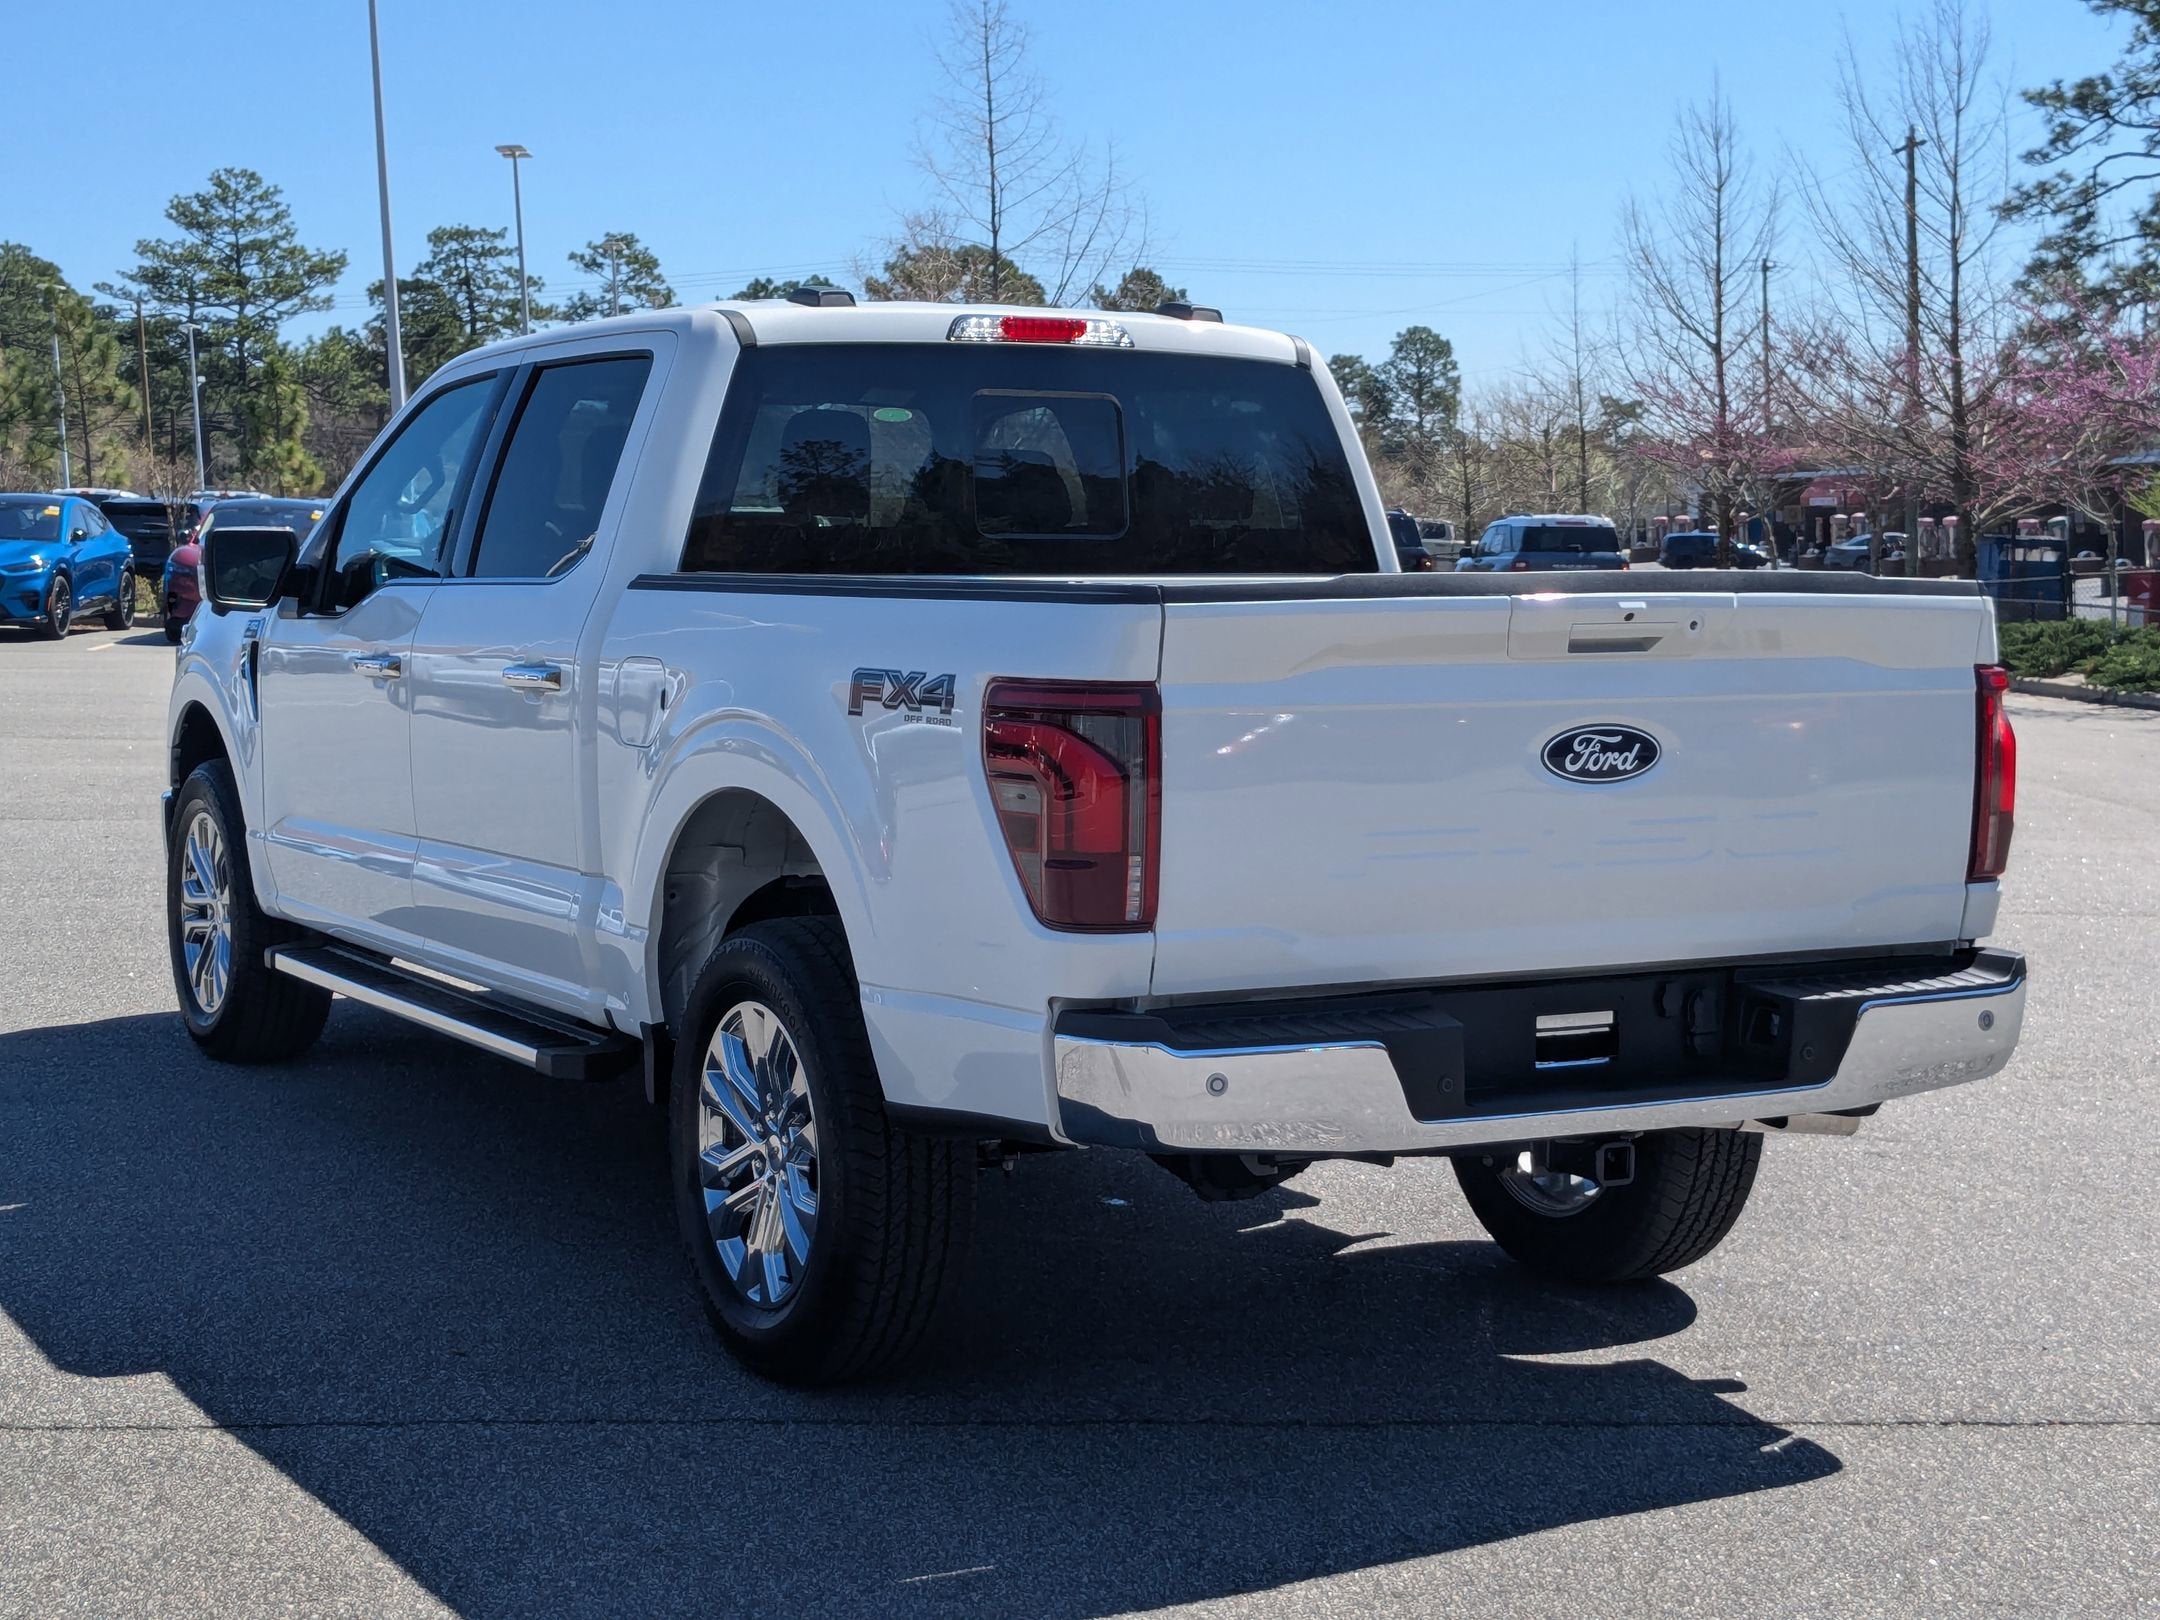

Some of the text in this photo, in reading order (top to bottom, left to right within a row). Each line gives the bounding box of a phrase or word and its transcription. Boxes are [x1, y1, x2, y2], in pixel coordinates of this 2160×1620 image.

[848, 667, 956, 716] FX4
[904, 714, 952, 727] OFF ROAD
[1565, 734, 1641, 772] Ford
